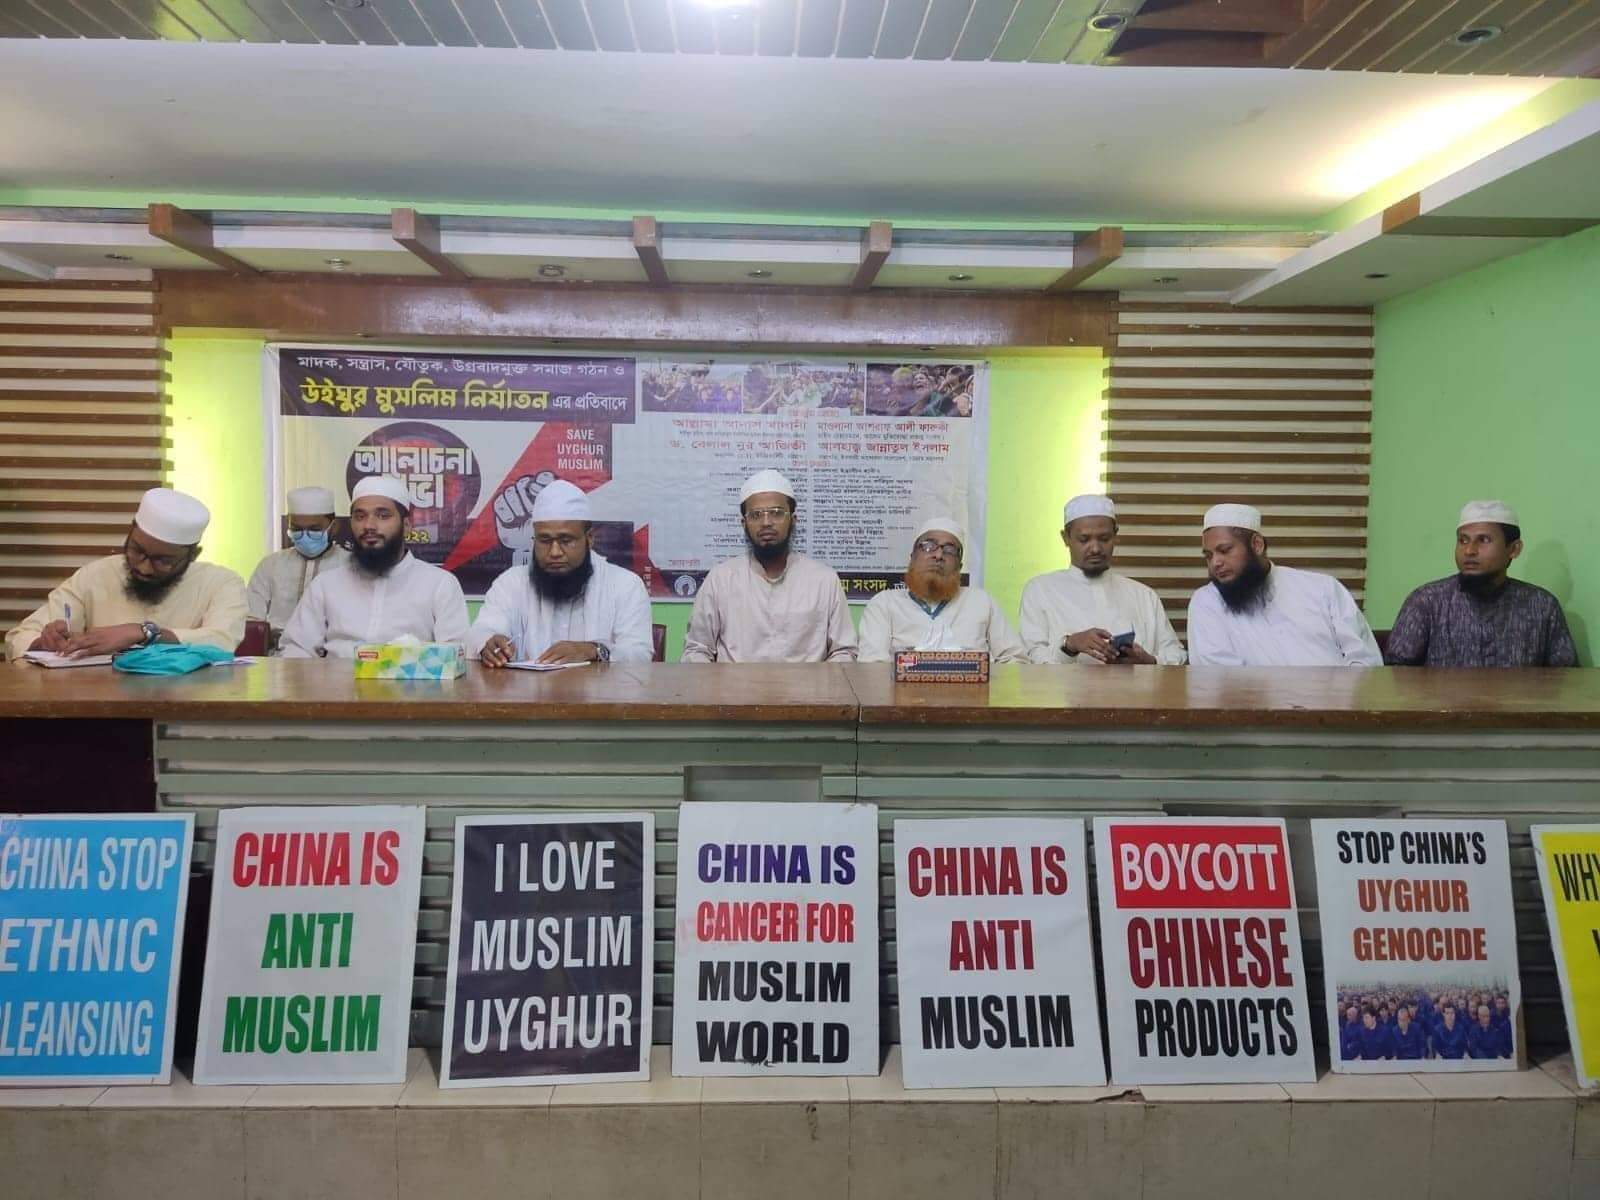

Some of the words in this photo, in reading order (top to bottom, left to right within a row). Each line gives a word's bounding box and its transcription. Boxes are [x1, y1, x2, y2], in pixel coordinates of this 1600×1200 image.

[297, 356, 343, 369] মাদক,
[533, 363, 573, 375] সমাজ
[577, 361, 608, 375] গঠন
[614, 365, 625, 375] ও
[374, 378, 457, 414] মুসলিম
[463, 379, 549, 410] নির্যাতন
[552, 396, 571, 409] এর
[575, 392, 628, 411] প্রতিবাদে
[557, 444, 604, 455] UYGHUR
[567, 429, 595, 440] SAVE
[354, 446, 473, 479] আলোচনা
[558, 459, 603, 470] MUSLIM
[0, 836, 88, 890] CHINA
[99, 837, 178, 891] STOP
[232, 832, 351, 887] CHINA
[360, 830, 400, 886] IS
[494, 843, 504, 893] I
[518, 840, 616, 891] LOVE
[698, 843, 811, 884] CHINA
[820, 845, 856, 885] IS
[908, 846, 1023, 897] CHINA
[1031, 845, 1068, 896] IS
[1119, 842, 1279, 892] BOYCOTT
[1337, 830, 1395, 864] STOP
[1400, 831, 1487, 865] CHINA'S
[1357, 878, 1470, 913] UYGHUR
[0, 918, 158, 973] ETHNIC
[261, 912, 354, 969] ANTI
[470, 916, 632, 972] MUSLIM
[696, 901, 799, 943] CANCER
[806, 903, 854, 943] FOR
[949, 919, 1034, 971] ANTI
[1353, 927, 1488, 962] GENOCIDE
[1127, 916, 1294, 989] CHINESE
[698, 960, 851, 1003] MUSLIM
[0, 1000, 153, 1056] LEANSING
[222, 995, 381, 1054] MUSLIM
[463, 993, 633, 1055] UYGHUR
[696, 1021, 850, 1064] WORLD
[920, 994, 1075, 1050] MUSLIM
[1135, 997, 1298, 1058] PRODUCTS
